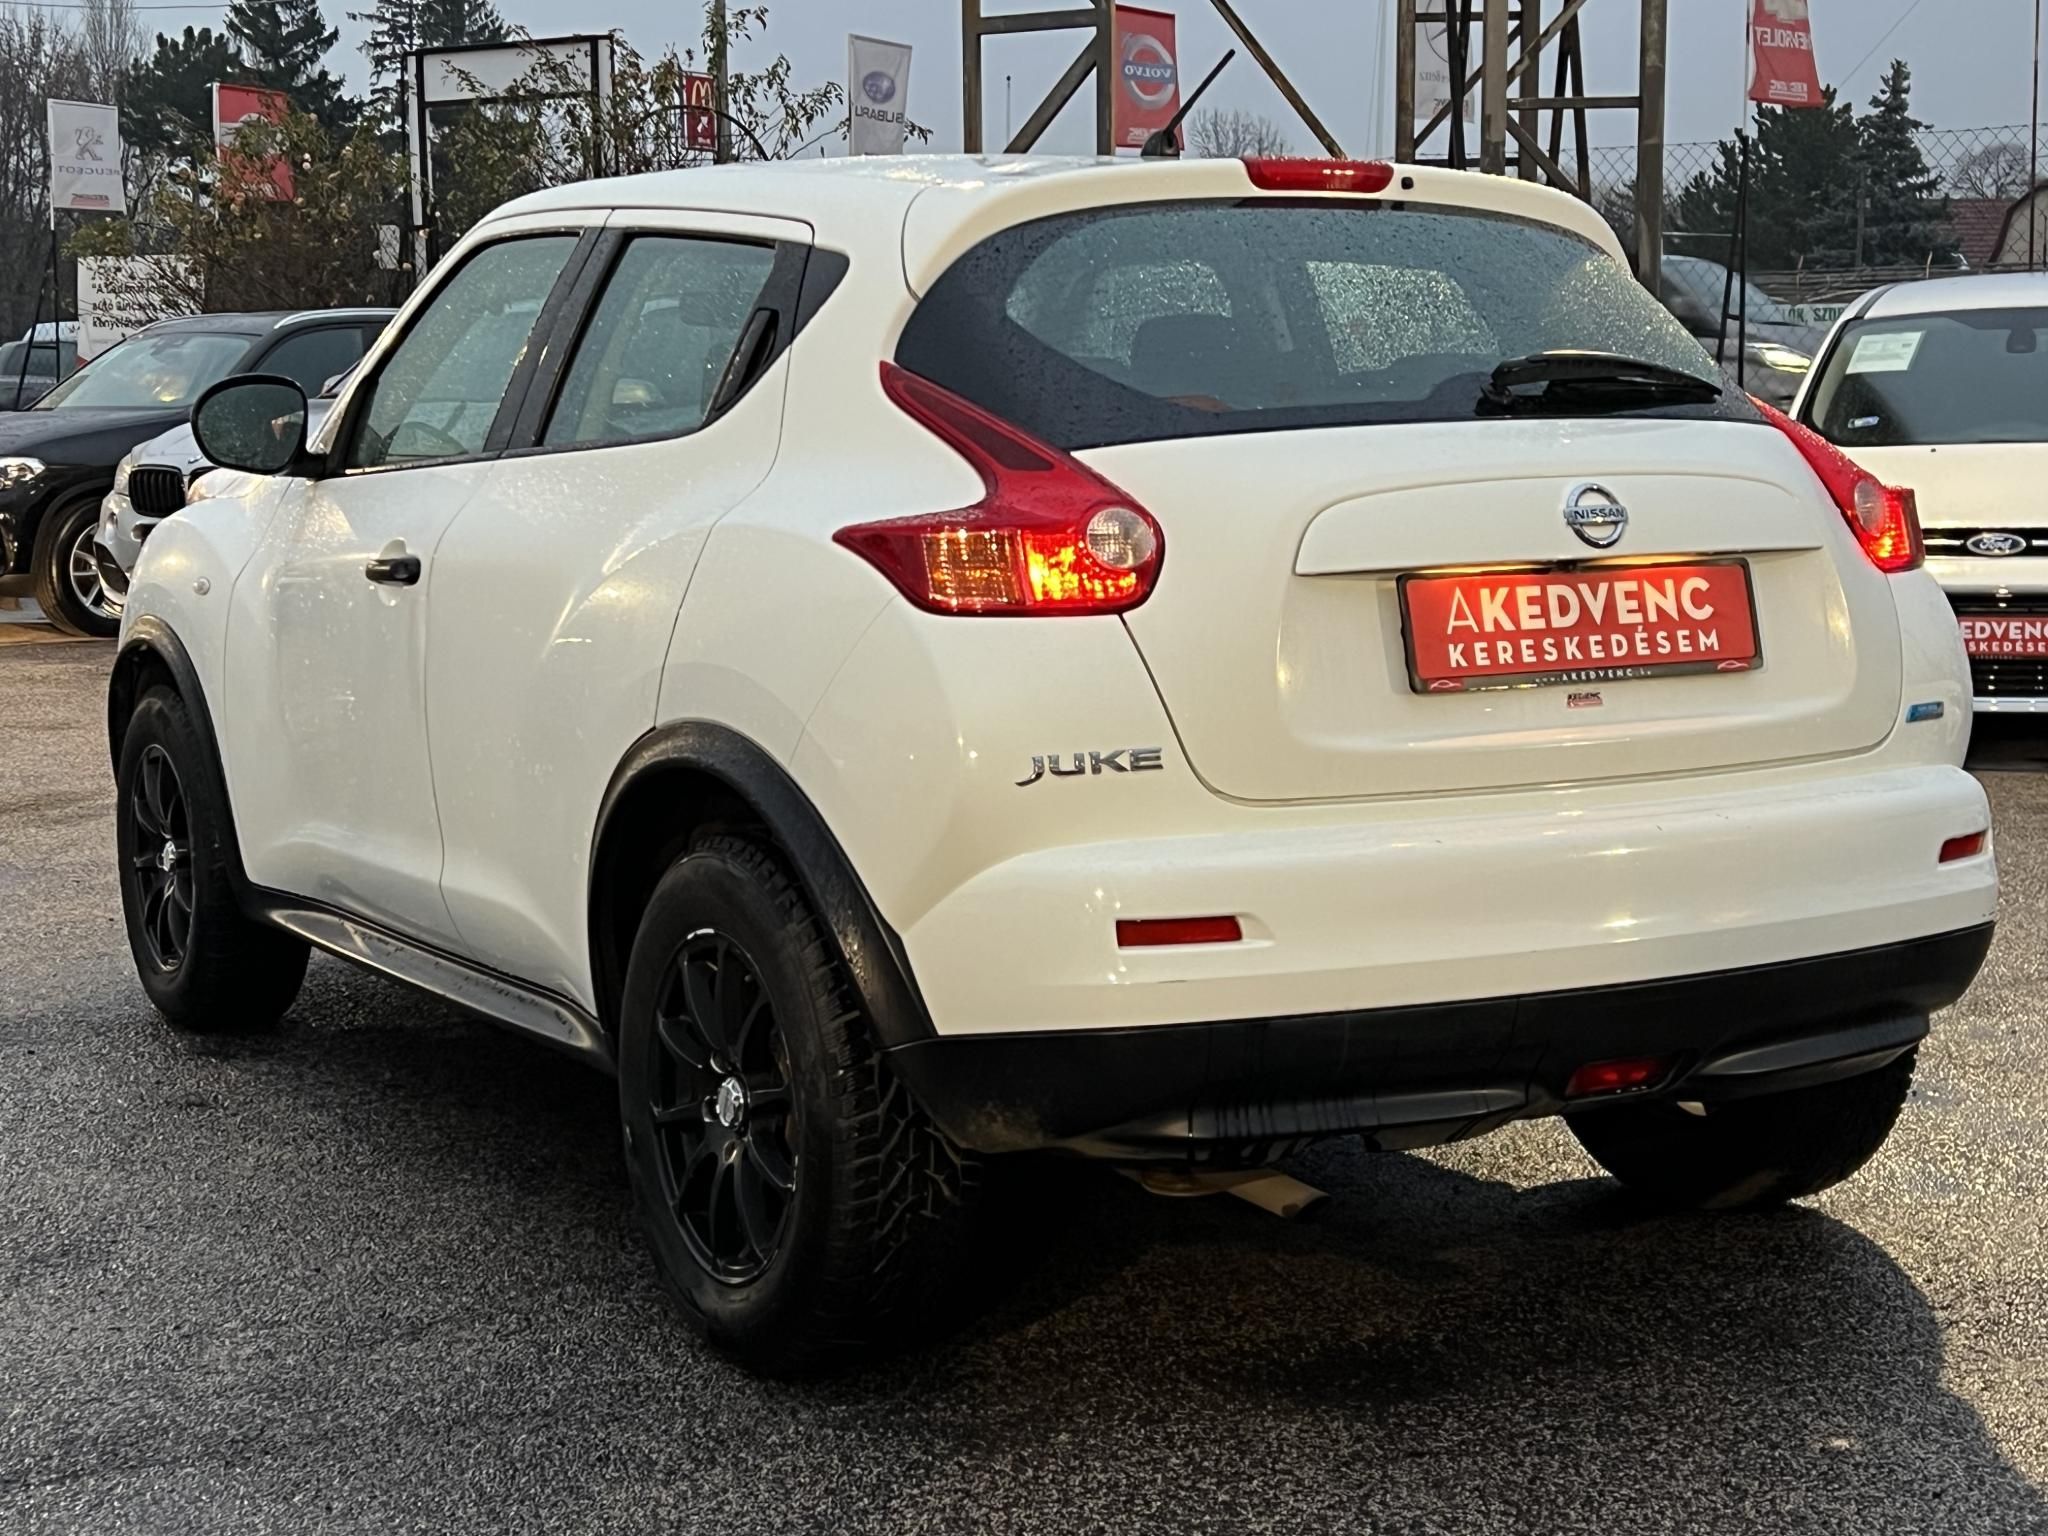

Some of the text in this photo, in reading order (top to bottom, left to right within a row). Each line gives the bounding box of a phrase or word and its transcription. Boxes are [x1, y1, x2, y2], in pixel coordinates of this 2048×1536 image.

[1573, 508, 1625, 520] NISSAN
[1979, 536, 2013, 550] Ford
[1446, 577, 1714, 635] AKEDVENC
[1960, 621, 2048, 640] EDVEN
[1448, 627, 1720, 668] KERESKEDÉSEM
[1968, 639, 2046, 653] SKEDÉSE
[1015, 747, 1164, 787] JUKE
